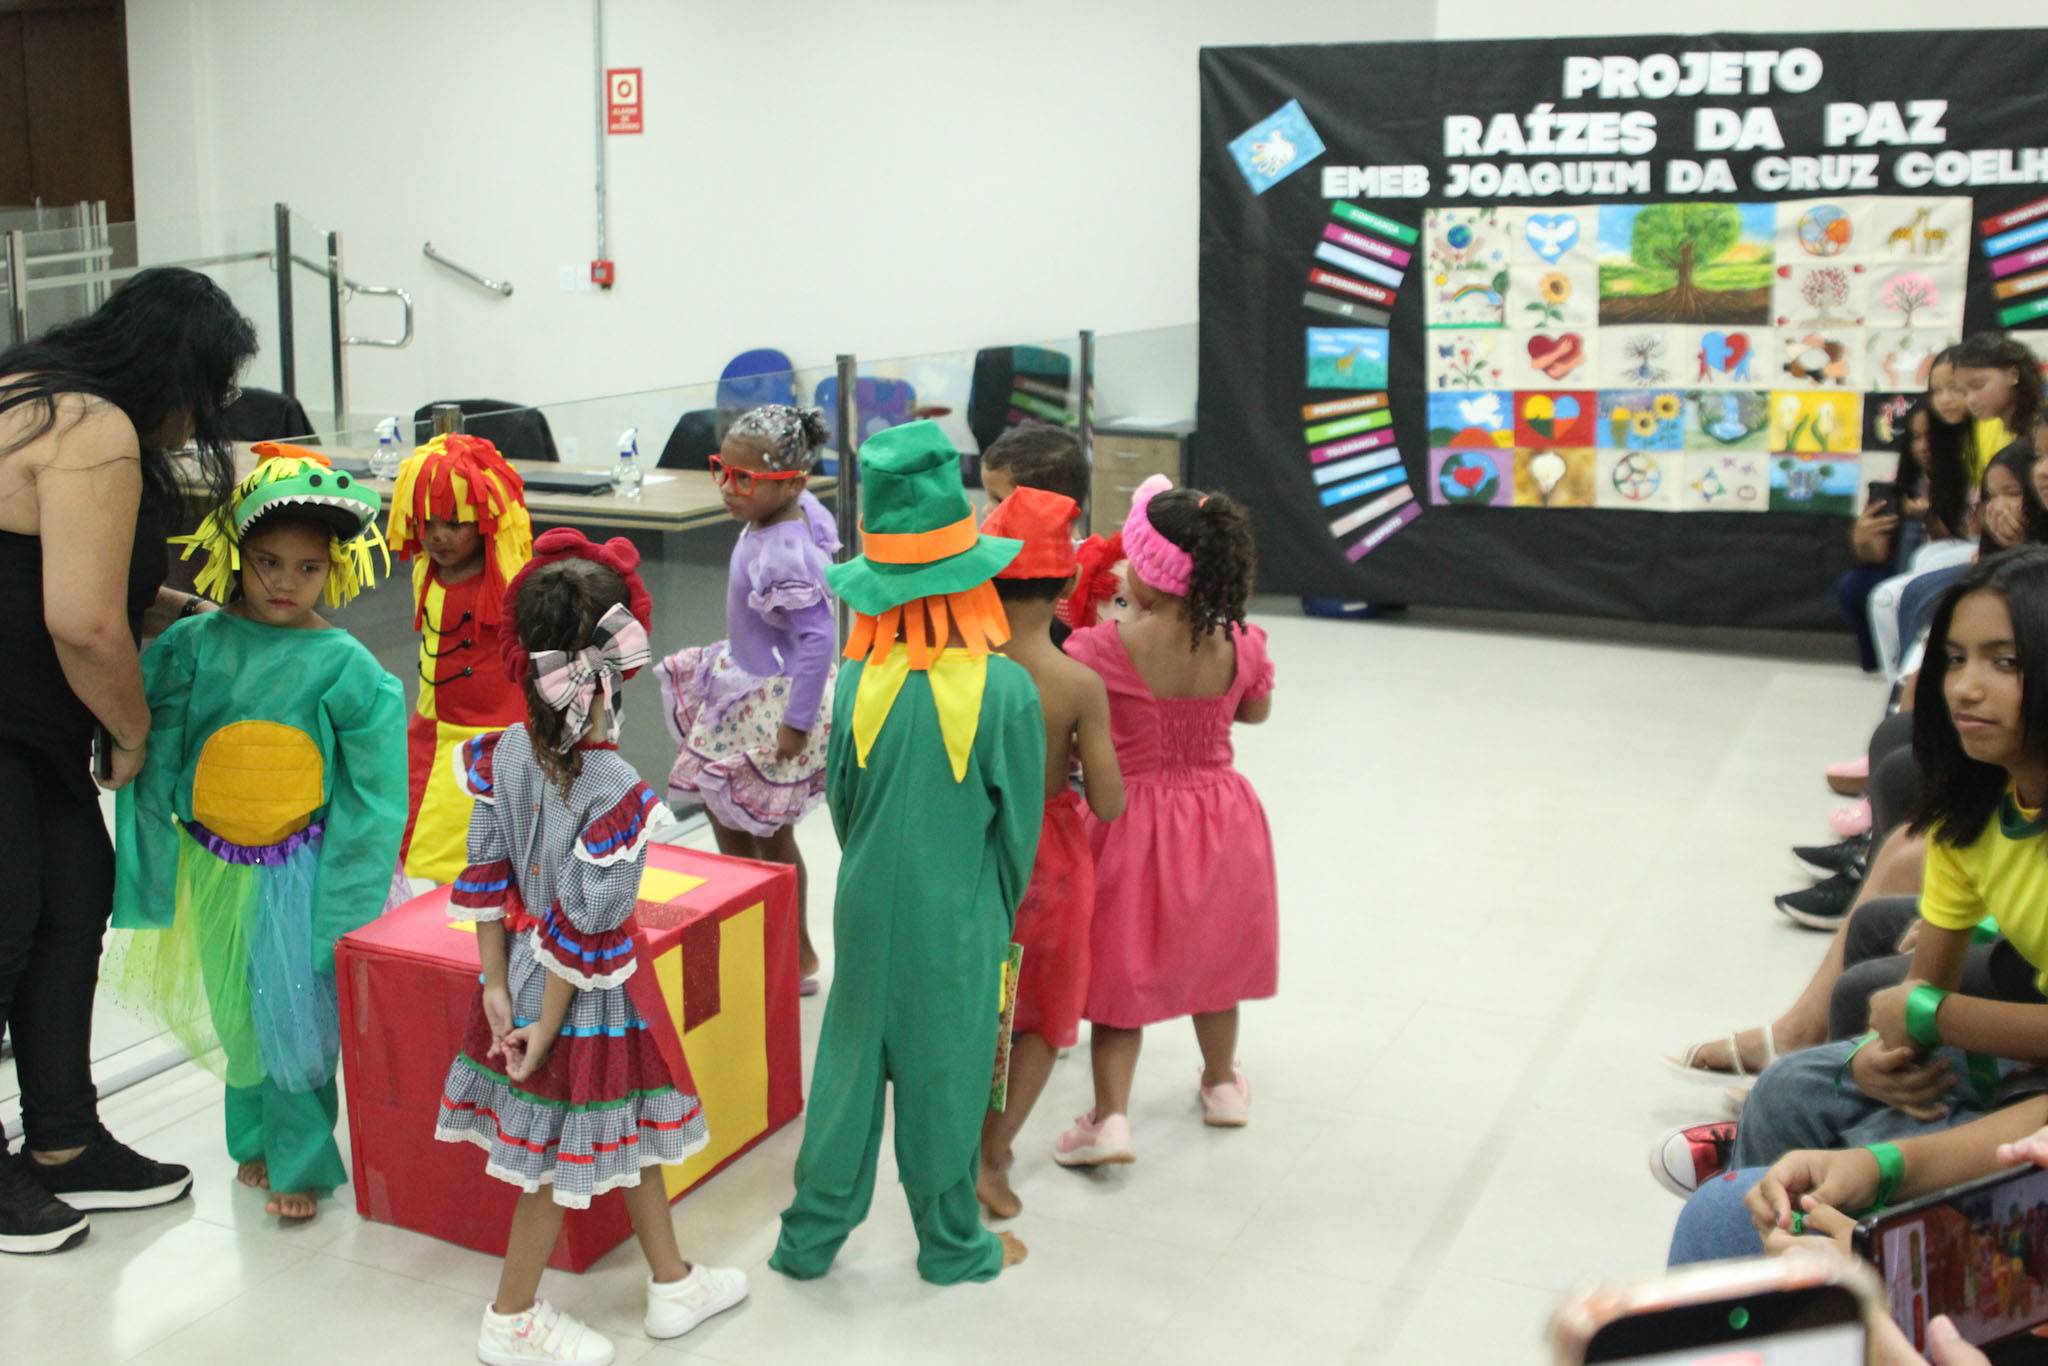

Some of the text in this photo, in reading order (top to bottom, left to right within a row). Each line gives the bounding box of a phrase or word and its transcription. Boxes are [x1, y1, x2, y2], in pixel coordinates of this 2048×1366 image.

[1562, 47, 1824, 99] PROJETO
[1443, 98, 1949, 158] RAÍZES DA PAZ
[1321, 164, 1431, 200] EMEB
[1442, 160, 1652, 198] JOAQUIM
[1665, 158, 1738, 195] DA
[1752, 153, 1880, 192] CRUZ
